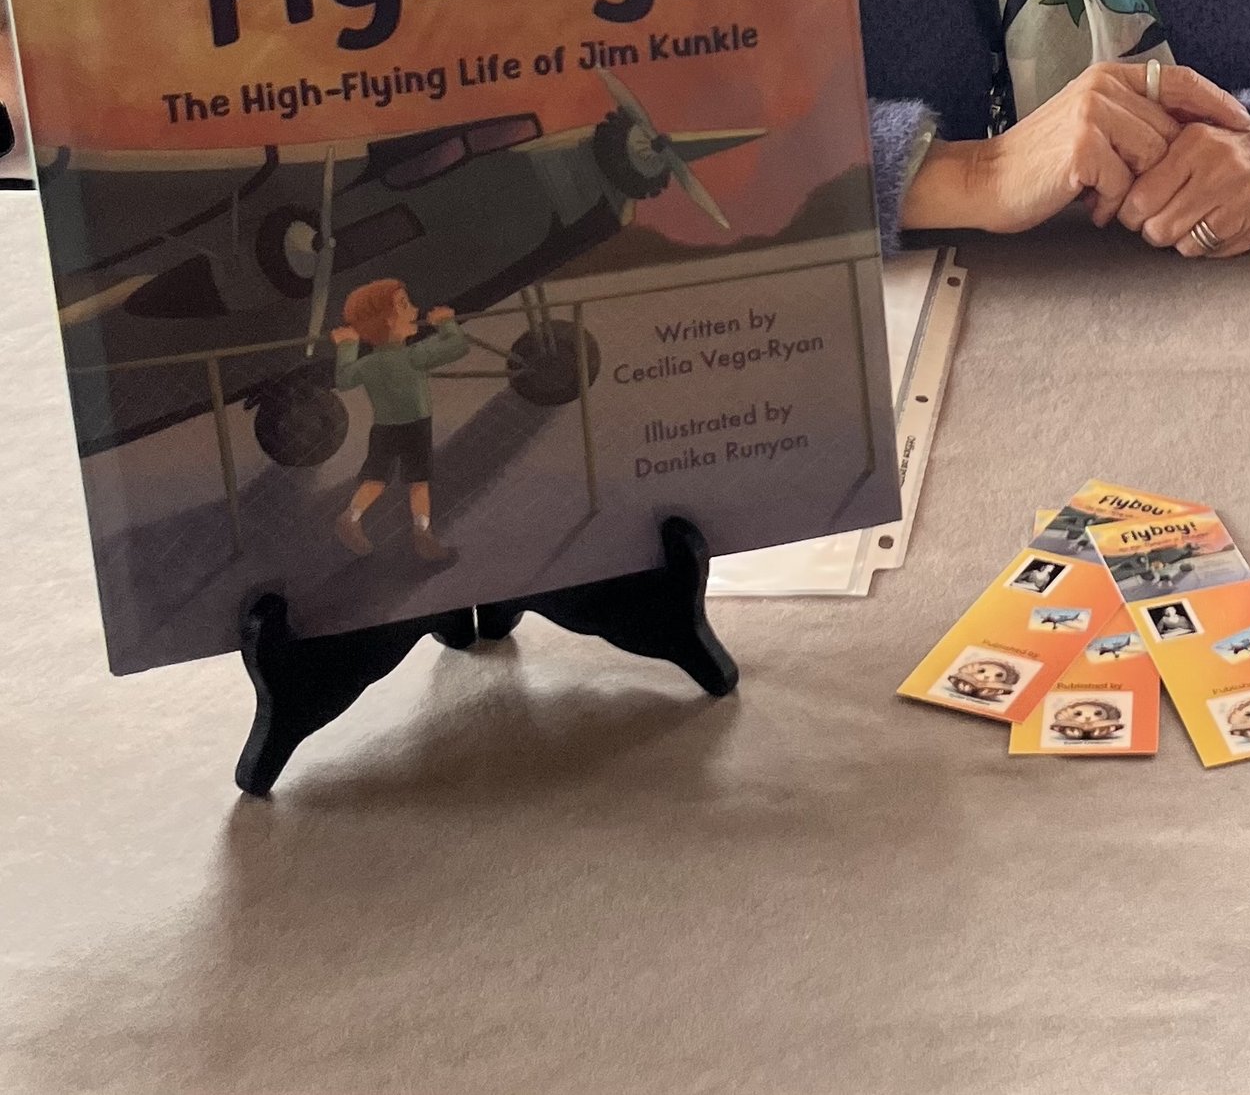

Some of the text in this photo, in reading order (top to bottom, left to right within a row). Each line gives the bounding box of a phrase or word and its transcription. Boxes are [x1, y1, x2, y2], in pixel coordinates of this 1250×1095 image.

[162, 23, 758, 124] The High-Flying Life of Jim Kunkle
[655, 308, 777, 343] Written by
[613, 336, 824, 384] Cecilia Vega-Ryan
[645, 401, 793, 443] Illustrated by
[635, 434, 809, 478] Danika Runyon
[1120, 521, 1197, 544] Flyboy!
